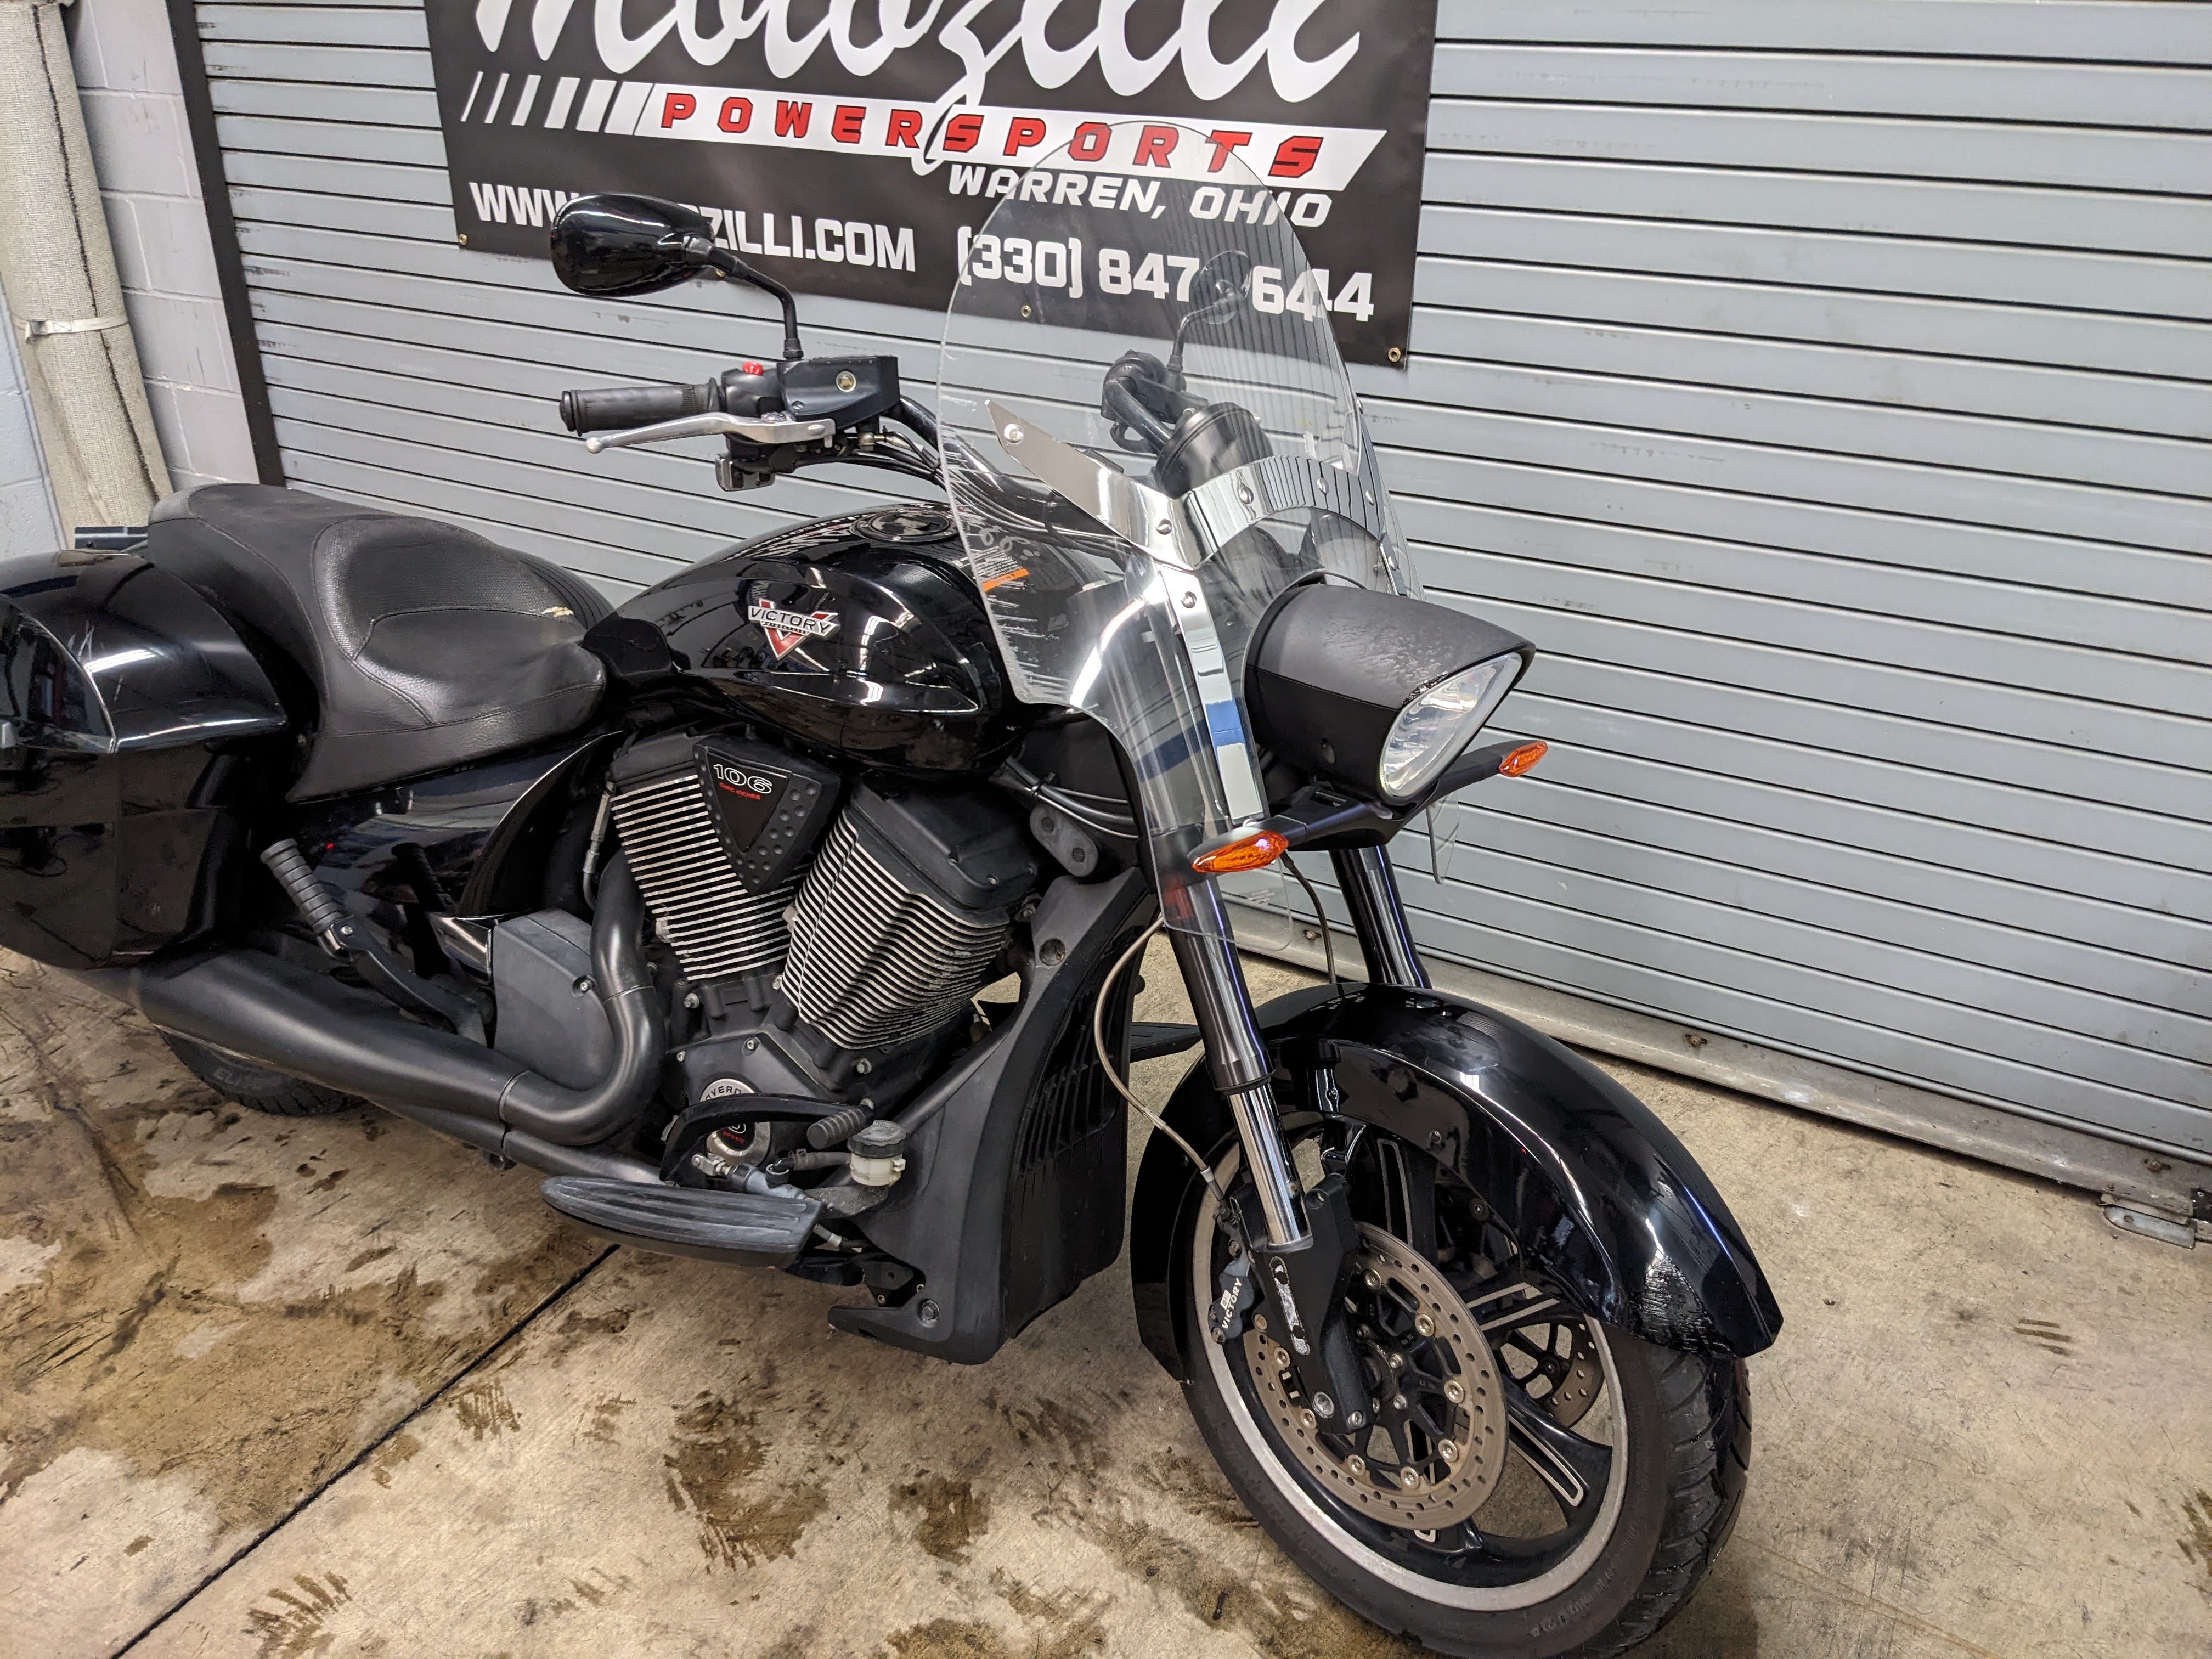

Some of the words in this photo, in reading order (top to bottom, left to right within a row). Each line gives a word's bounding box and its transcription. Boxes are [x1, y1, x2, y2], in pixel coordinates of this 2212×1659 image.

[661, 92, 1324, 179] POWERSPORTS
[949, 165, 1166, 219] WARREN,
[1189, 187, 1333, 228] OHIO
[469, 182, 915, 272] WWZILLI.COM
[957, 226, 1082, 299] (330)
[1099, 249, 1374, 322] 847644
[752, 607, 831, 633] VICTORY
[713, 764, 773, 794] 106
[705, 1085, 742, 1100] OVERD
[1221, 1277, 1242, 1329] VICTORY
